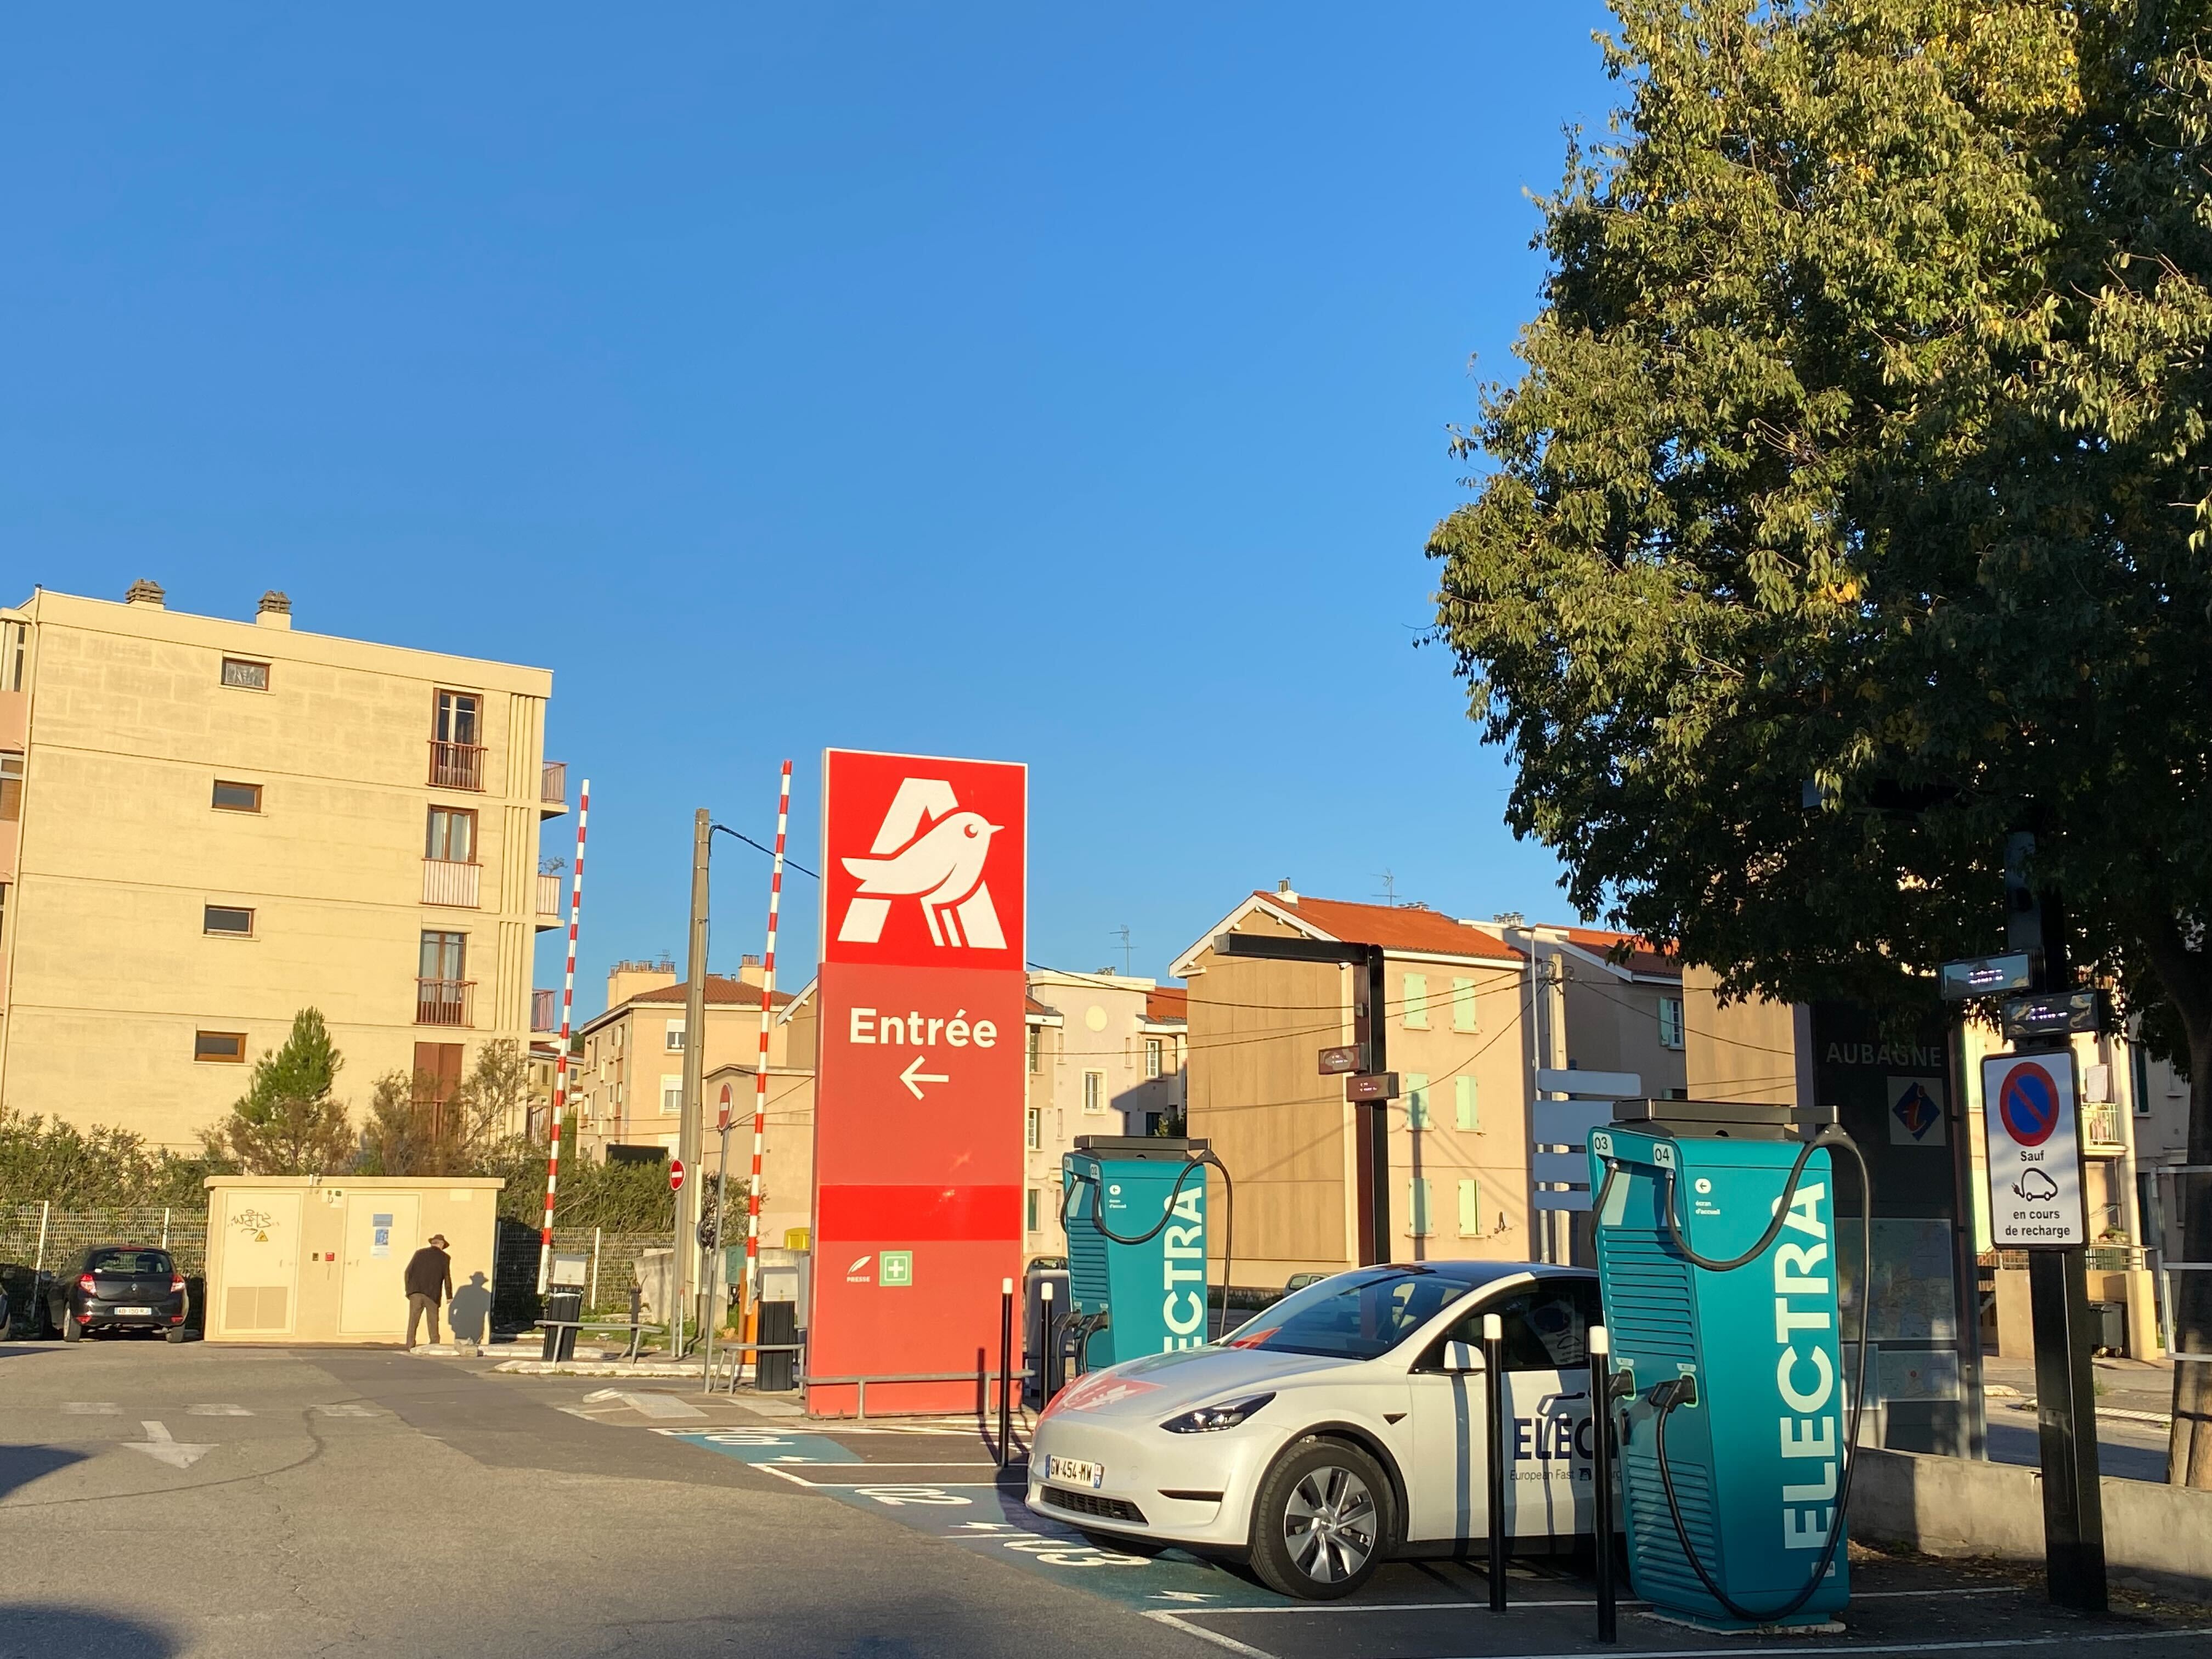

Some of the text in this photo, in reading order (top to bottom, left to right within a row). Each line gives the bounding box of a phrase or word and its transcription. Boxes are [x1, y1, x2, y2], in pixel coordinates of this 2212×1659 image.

[850, 1007, 997, 1048] Entrée
[1826, 1042, 1942, 1067] AUBAGNE
[1594, 1137, 1608, 1150] 03
[1655, 1148, 1670, 1161] 04
[2021, 1150, 2044, 1161] Sauf
[2030, 1211, 2060, 1219] cours
[2005, 1225, 2070, 1238] de recharge
[1163, 1187, 1203, 1353] ECTRA
[1771, 1182, 1838, 1549] ELECTRA
[1514, 1418, 1617, 1459] ELEC
[1510, 1470, 1553, 1481] European
[1556, 1469, 1575, 1480] Fast
